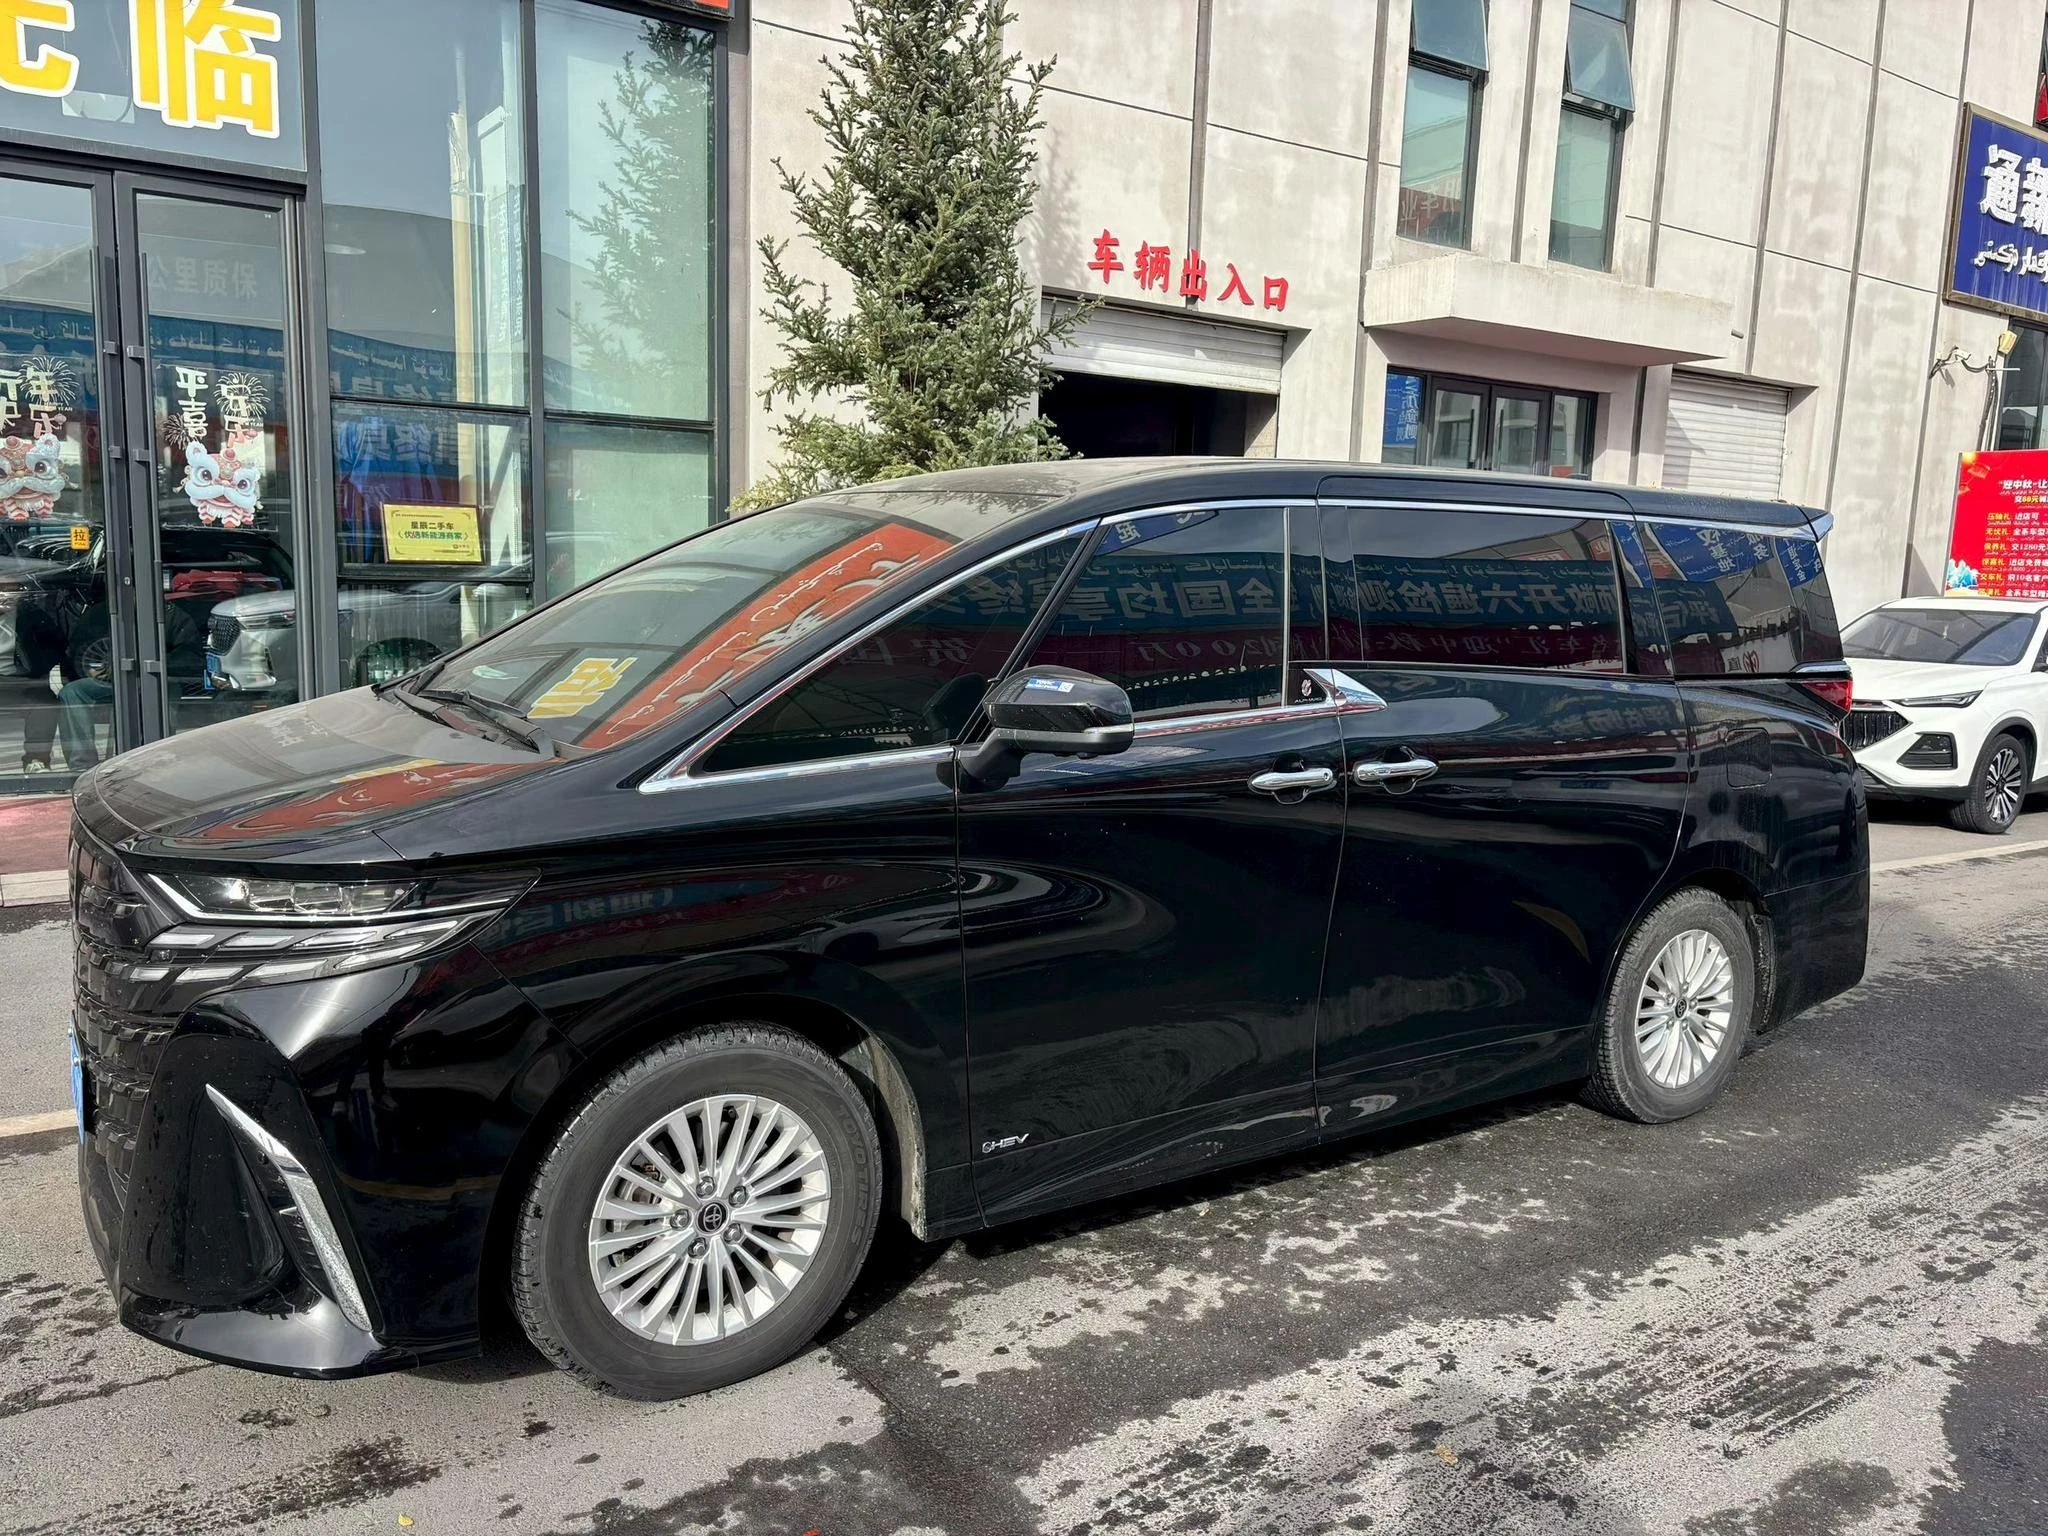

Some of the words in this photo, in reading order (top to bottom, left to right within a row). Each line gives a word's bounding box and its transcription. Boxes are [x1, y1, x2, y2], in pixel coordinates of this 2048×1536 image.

[1087, 228, 1289, 311] 车辆出入口
